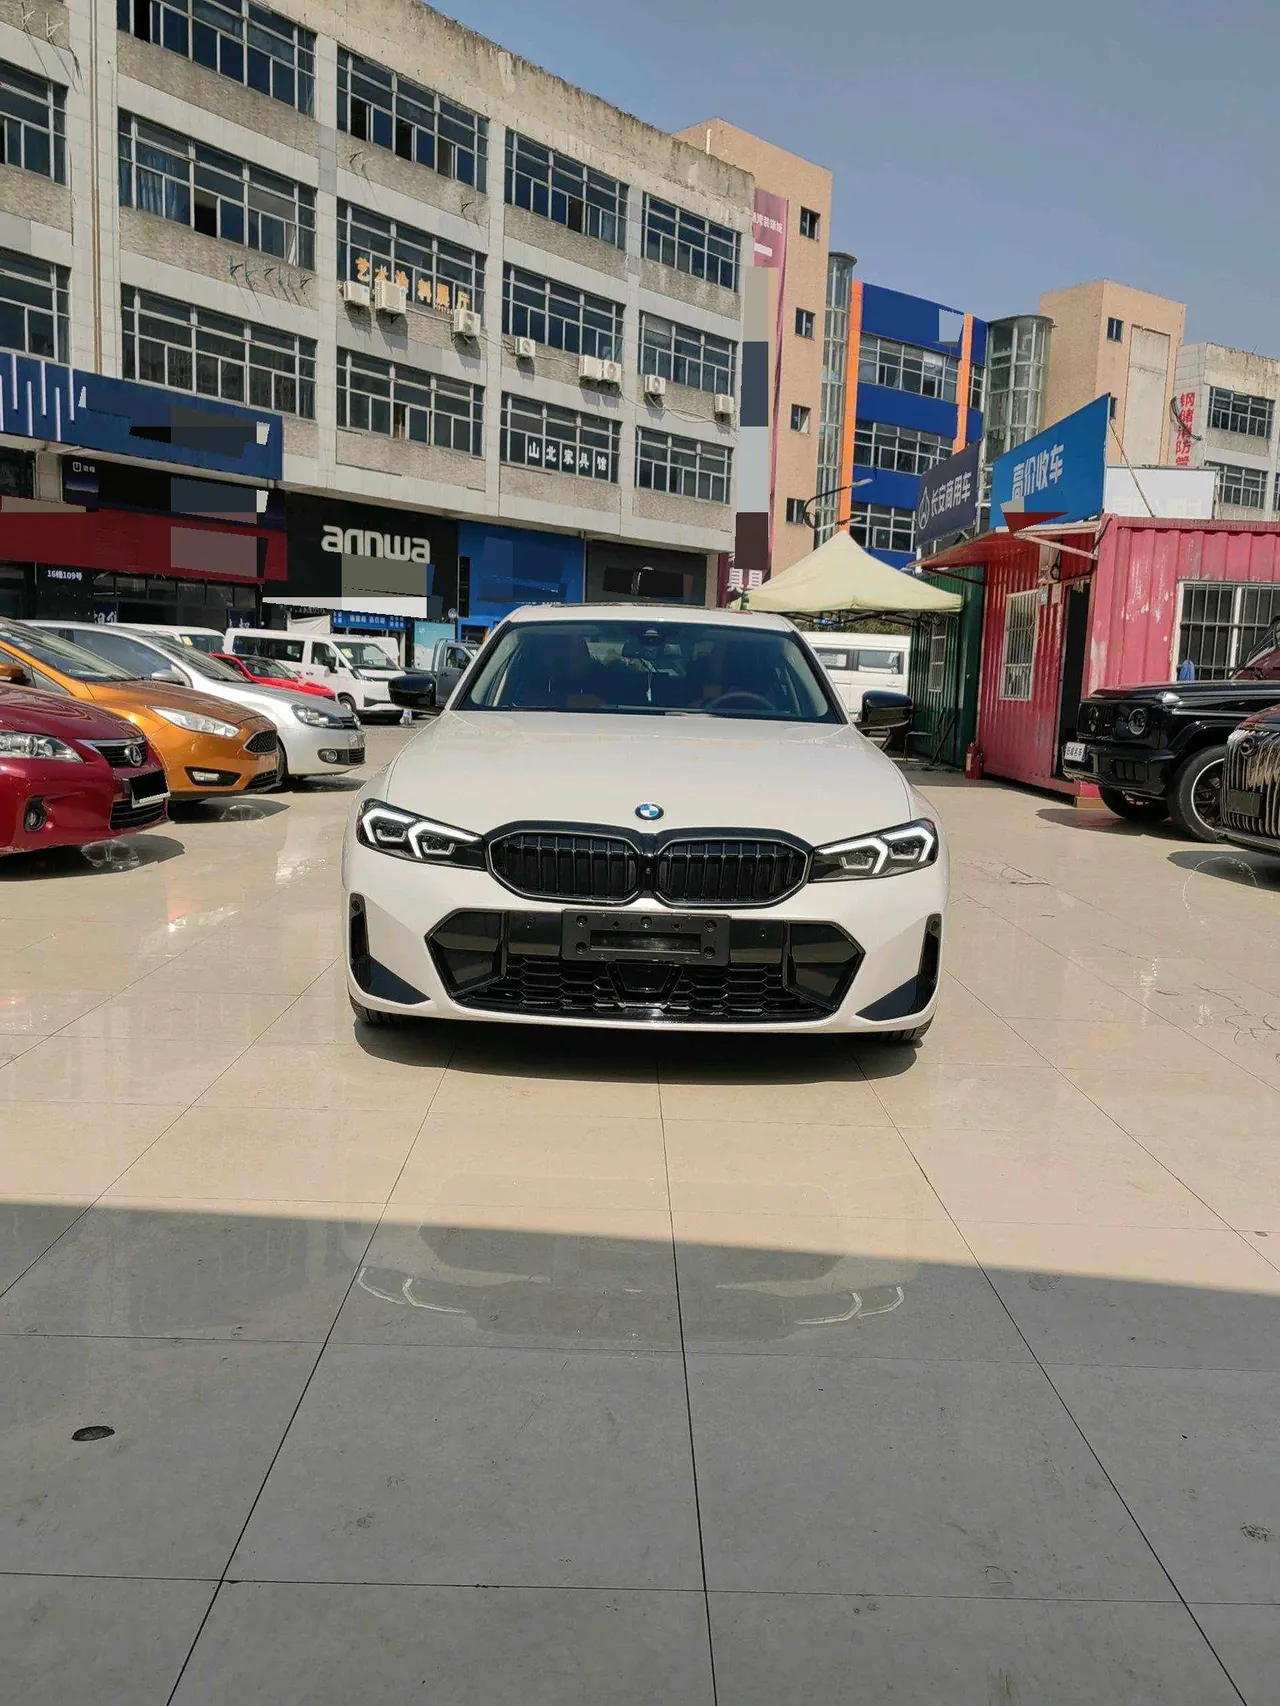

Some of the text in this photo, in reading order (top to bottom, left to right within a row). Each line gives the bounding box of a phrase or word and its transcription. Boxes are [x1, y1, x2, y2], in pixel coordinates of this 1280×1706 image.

[528, 441, 607, 471] 山北家具馆
[1012, 444, 1065, 501] 高价收车
[931, 471, 972, 517] 长安商用车
[321, 525, 430, 564] annwa
